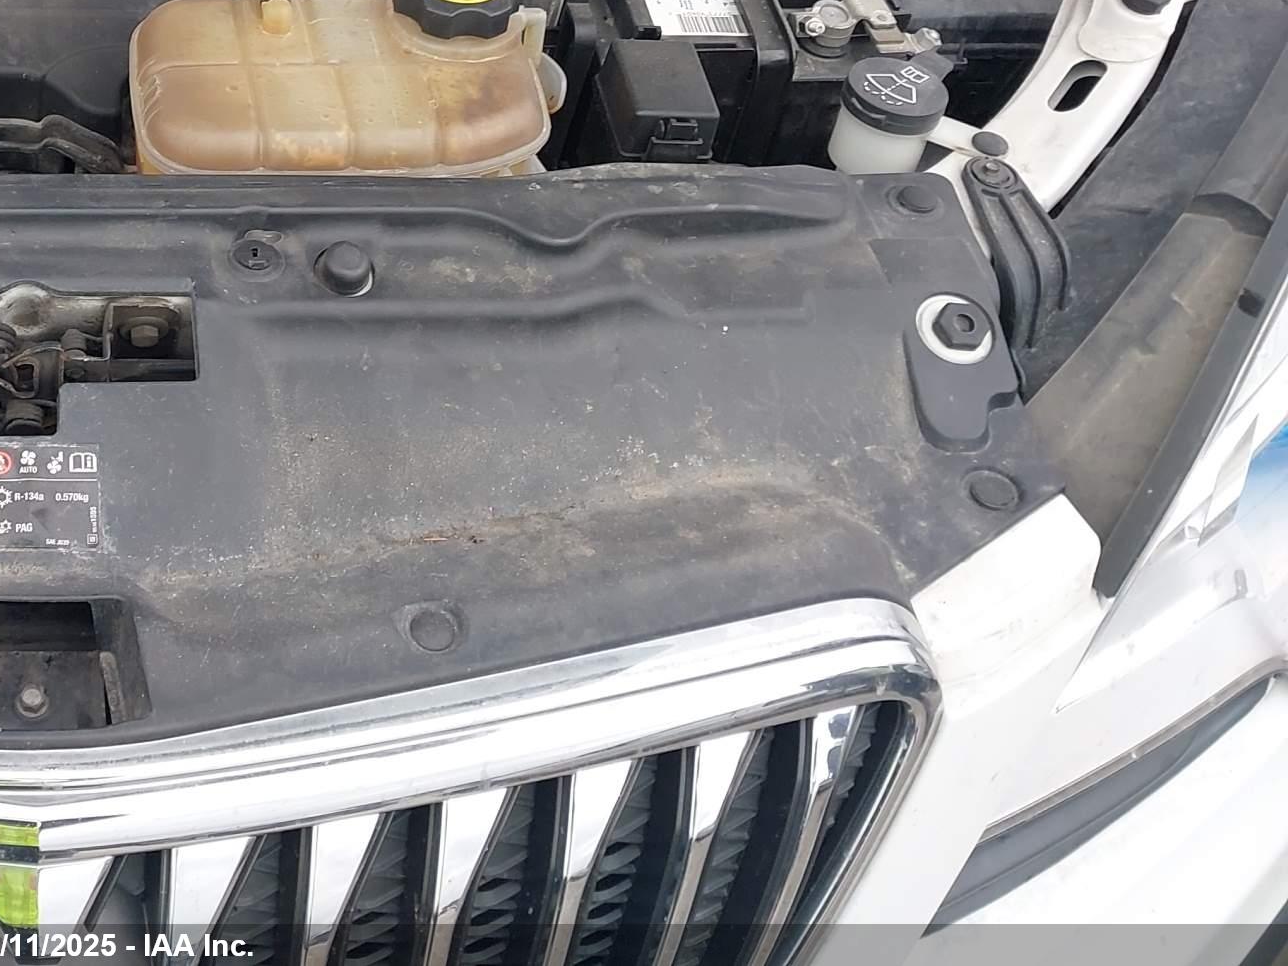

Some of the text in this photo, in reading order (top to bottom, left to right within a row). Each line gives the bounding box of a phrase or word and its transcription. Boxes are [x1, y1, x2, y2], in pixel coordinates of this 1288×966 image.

[18, 466, 38, 474] AUTO
[14, 491, 89, 503] R-134a 0.570kg
[15, 522, 33, 533] PAG
